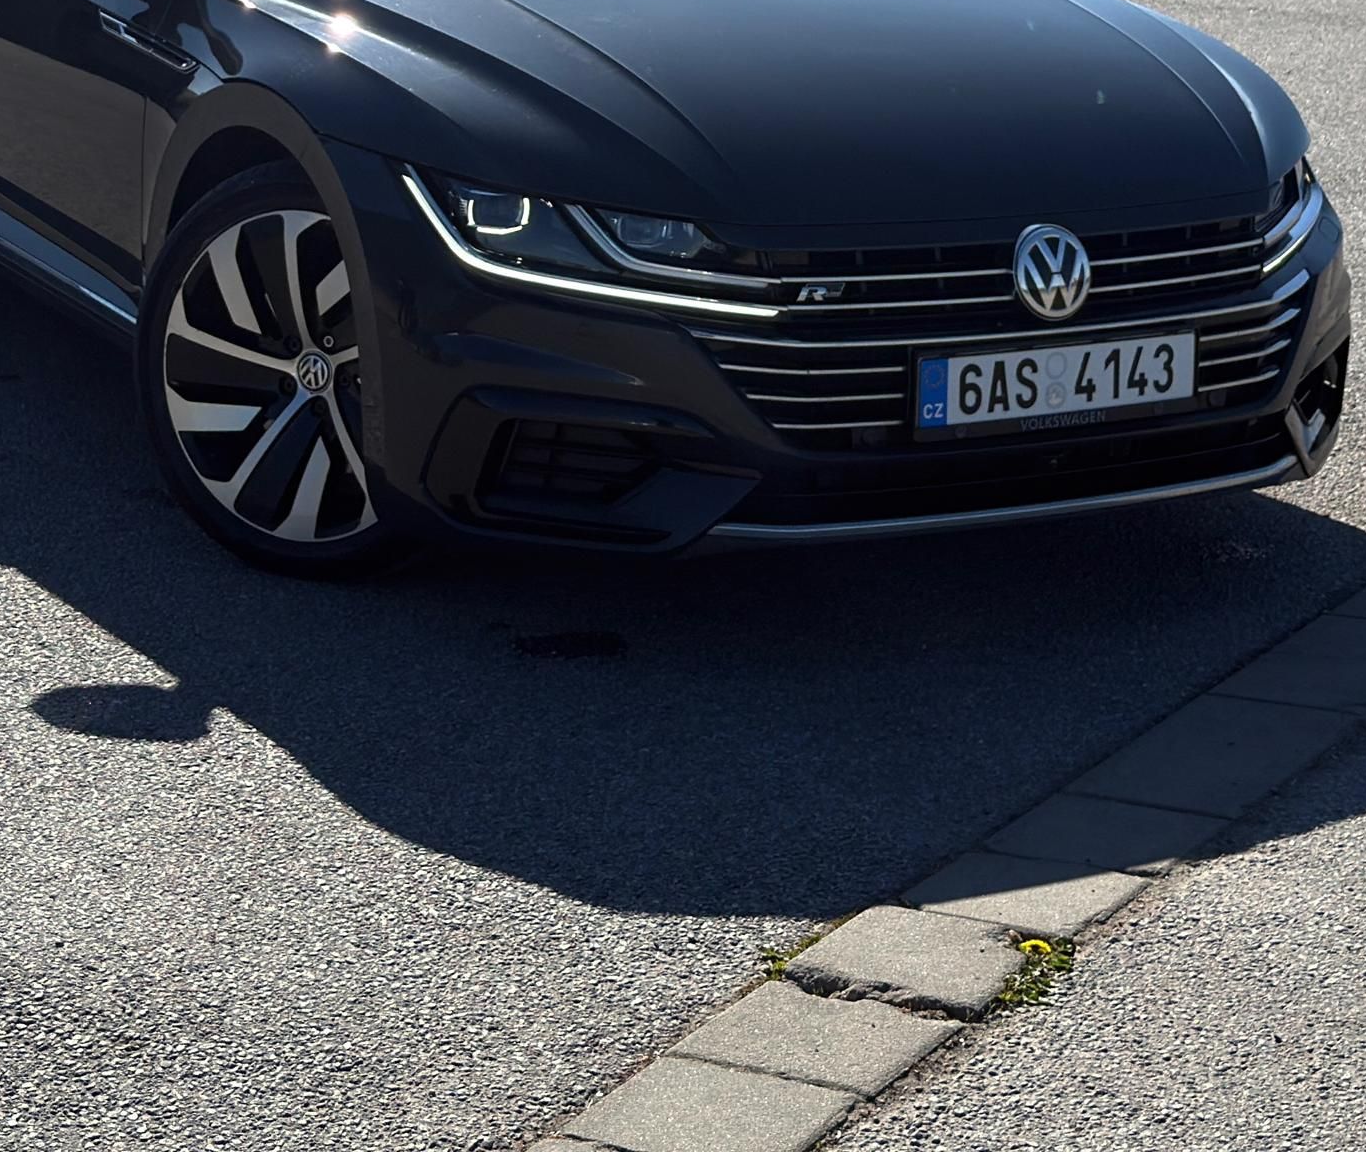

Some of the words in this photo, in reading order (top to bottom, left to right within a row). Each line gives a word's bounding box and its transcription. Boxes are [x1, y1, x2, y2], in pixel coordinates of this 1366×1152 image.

[958, 357, 1039, 416] 6AS
[1074, 343, 1175, 403] 4143
[922, 402, 944, 419] CZ
[1020, 411, 1107, 432] VOLKSWAGEN
